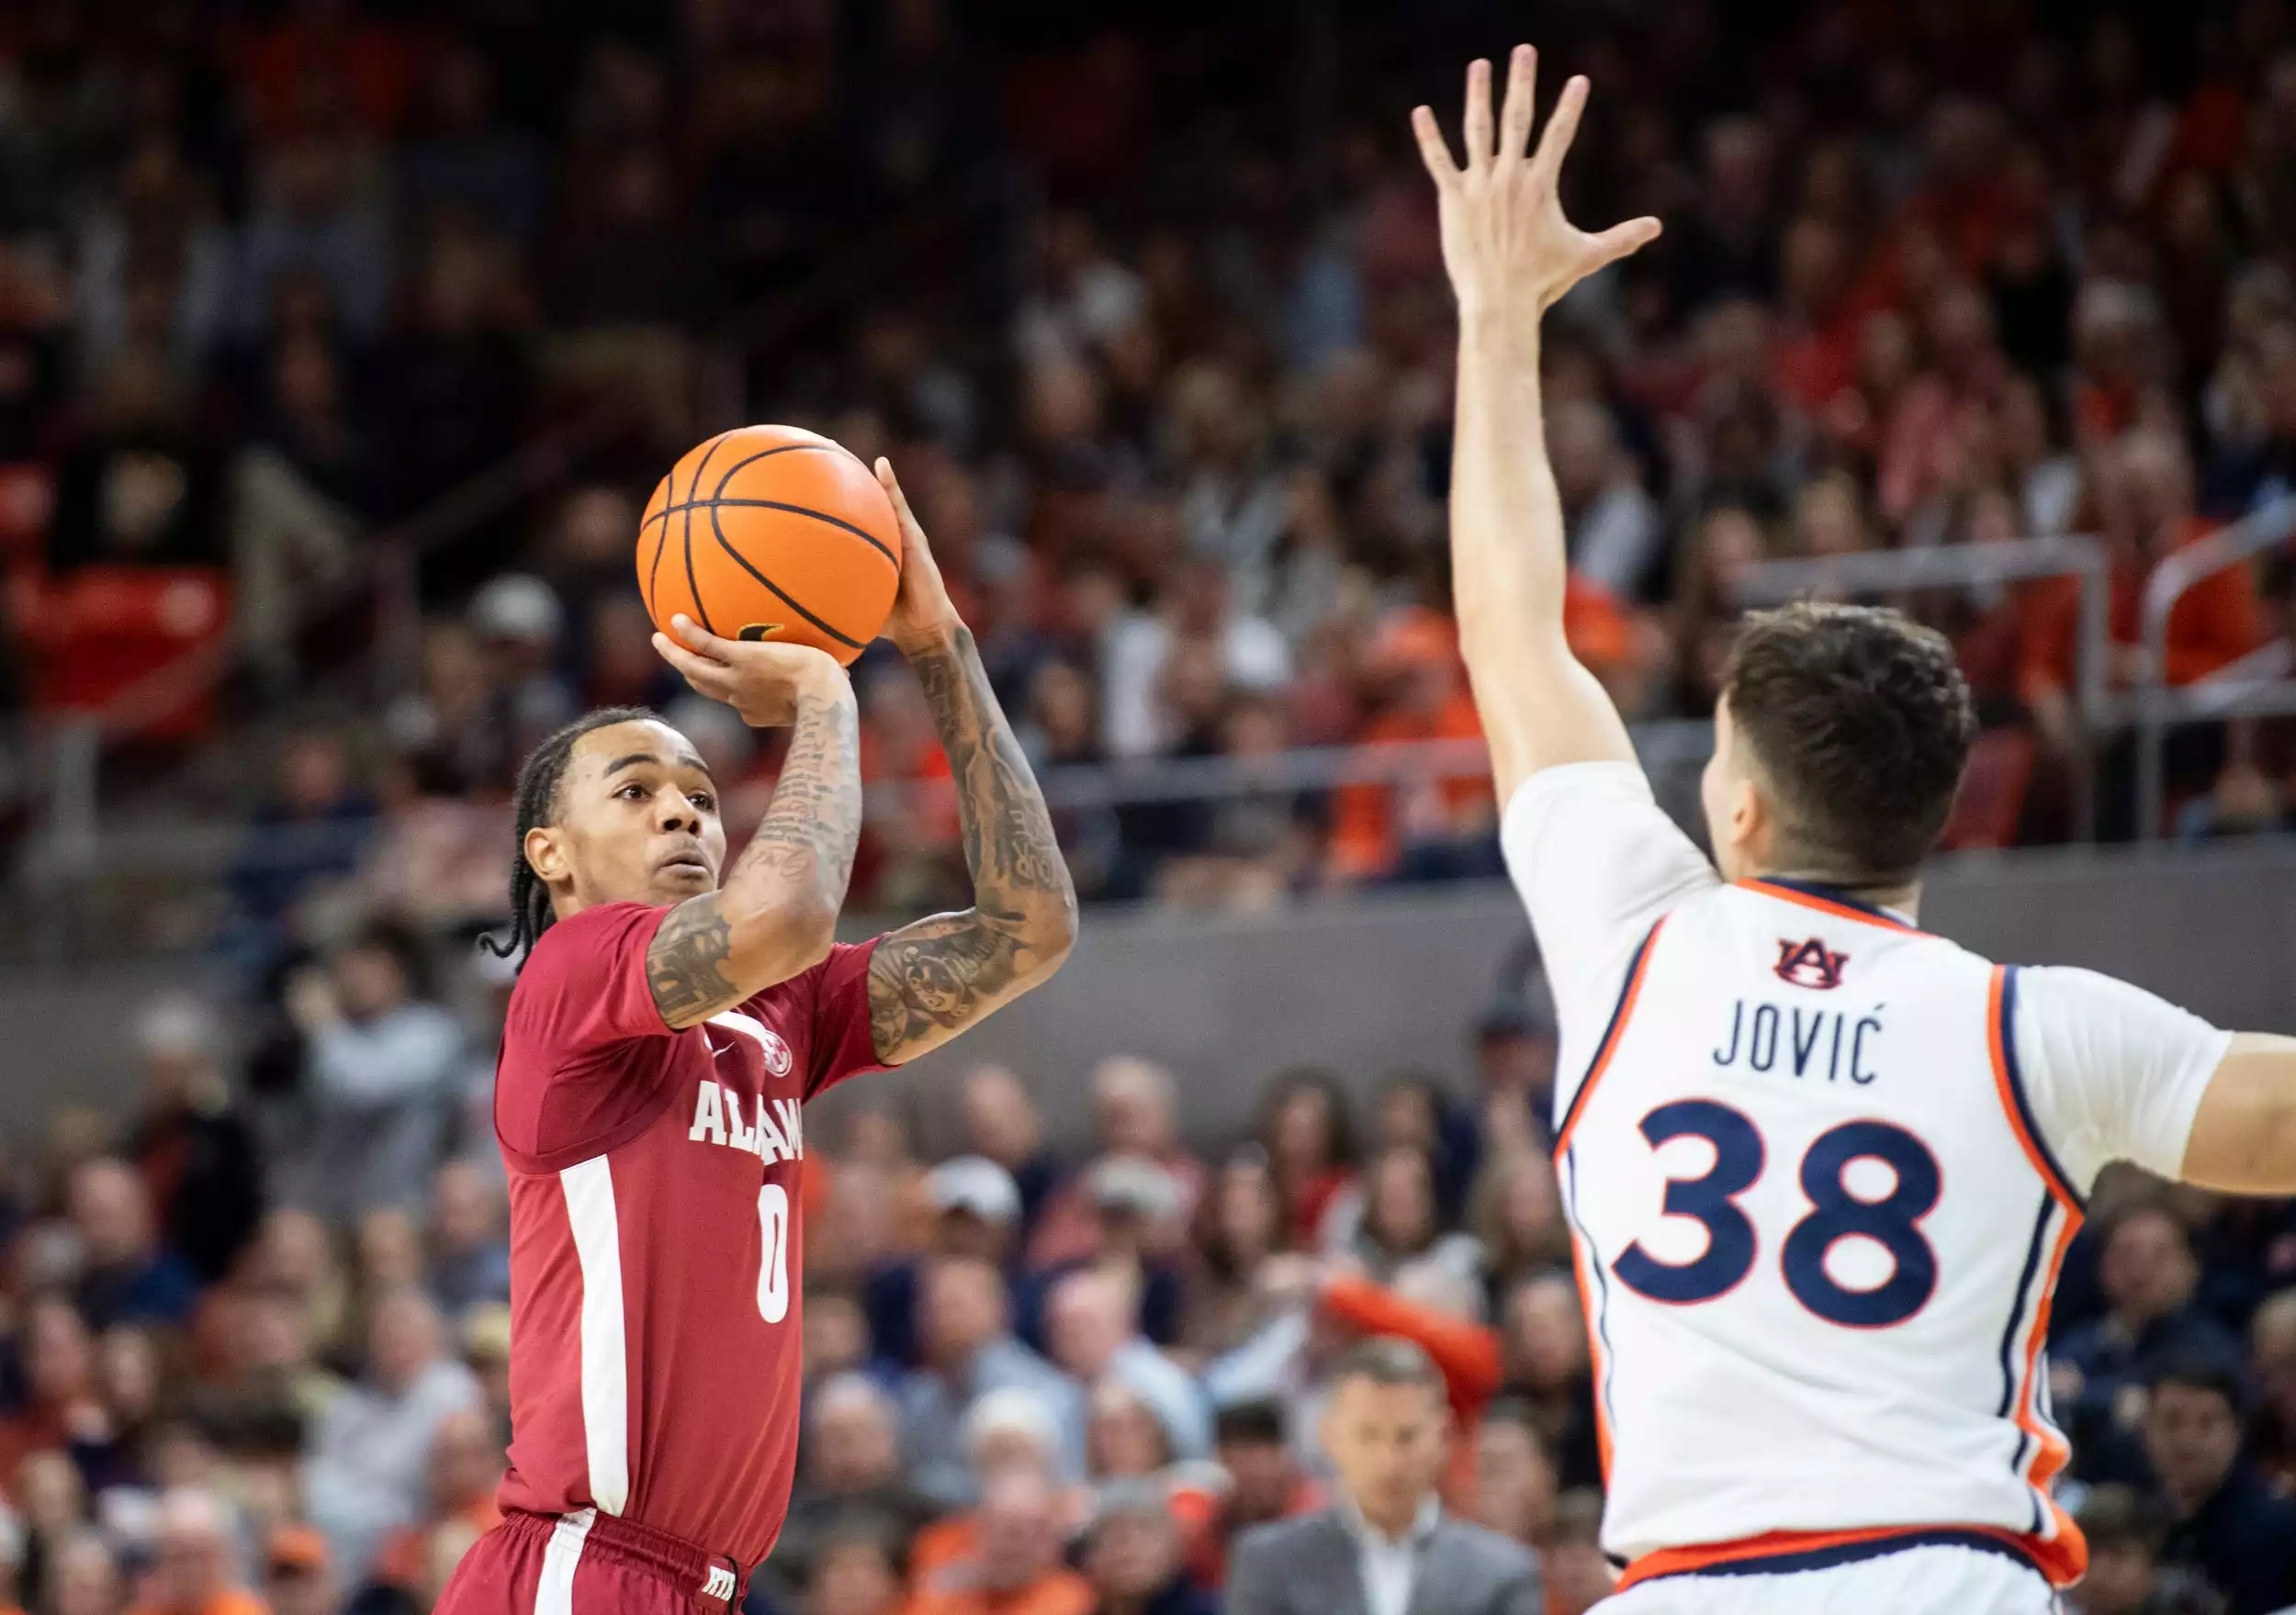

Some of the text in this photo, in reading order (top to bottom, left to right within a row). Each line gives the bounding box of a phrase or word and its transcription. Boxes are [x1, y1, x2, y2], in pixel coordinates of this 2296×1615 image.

[1714, 999, 1885, 1084] JOVIĆ
[757, 1183, 789, 1323] 0
[1610, 1098, 1943, 1329] 38
